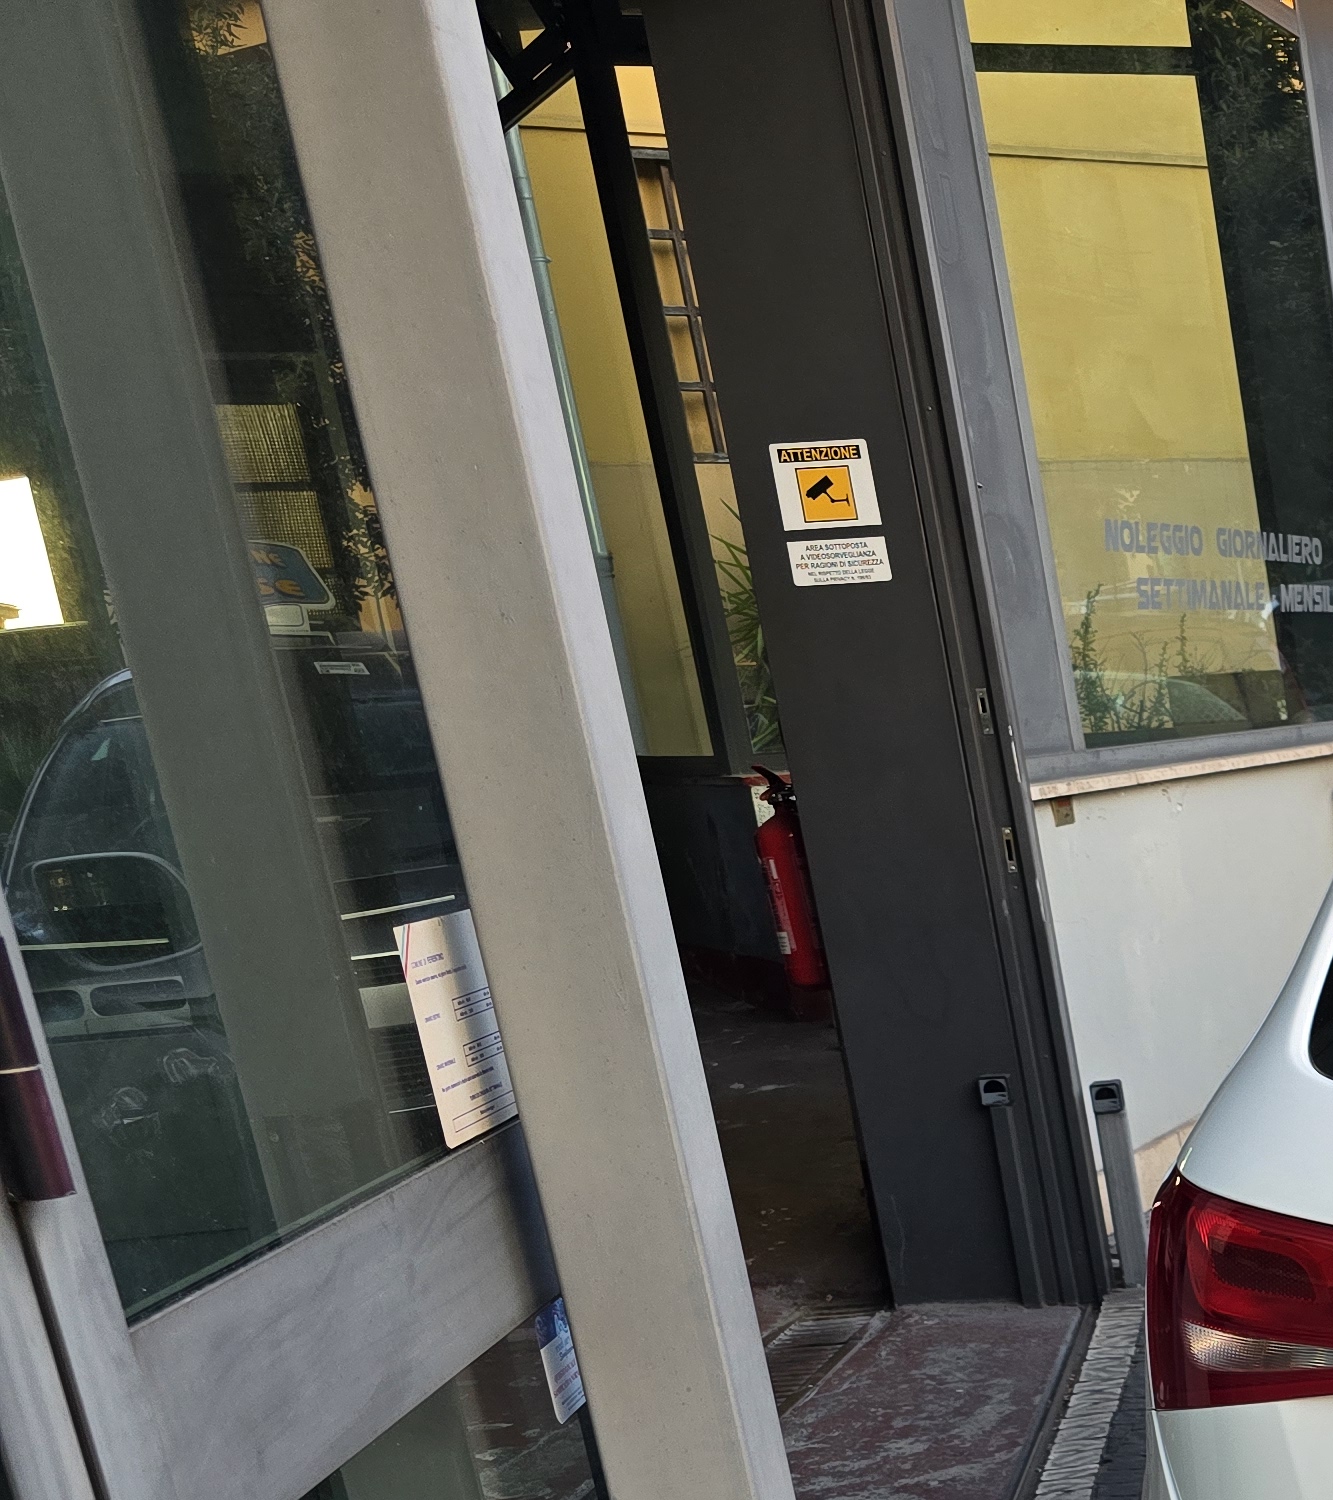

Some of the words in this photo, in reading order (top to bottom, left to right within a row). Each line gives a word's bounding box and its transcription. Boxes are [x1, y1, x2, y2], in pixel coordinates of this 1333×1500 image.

[780, 446, 859, 462] ATTENZIONE
[825, 541, 868, 550] SOTTOPOSTA
[1104, 518, 1204, 557] NOLEGGIO
[1215, 527, 1323, 566] GIORNALIERO
[806, 550, 876, 560] VIDEOSORVEGLIANZA
[811, 561, 838, 569] RAGIONI
[840, 560, 847, 568] DI
[848, 559, 884, 567] SICUREZZA
[1136, 577, 1266, 612] SETTIMANALE
